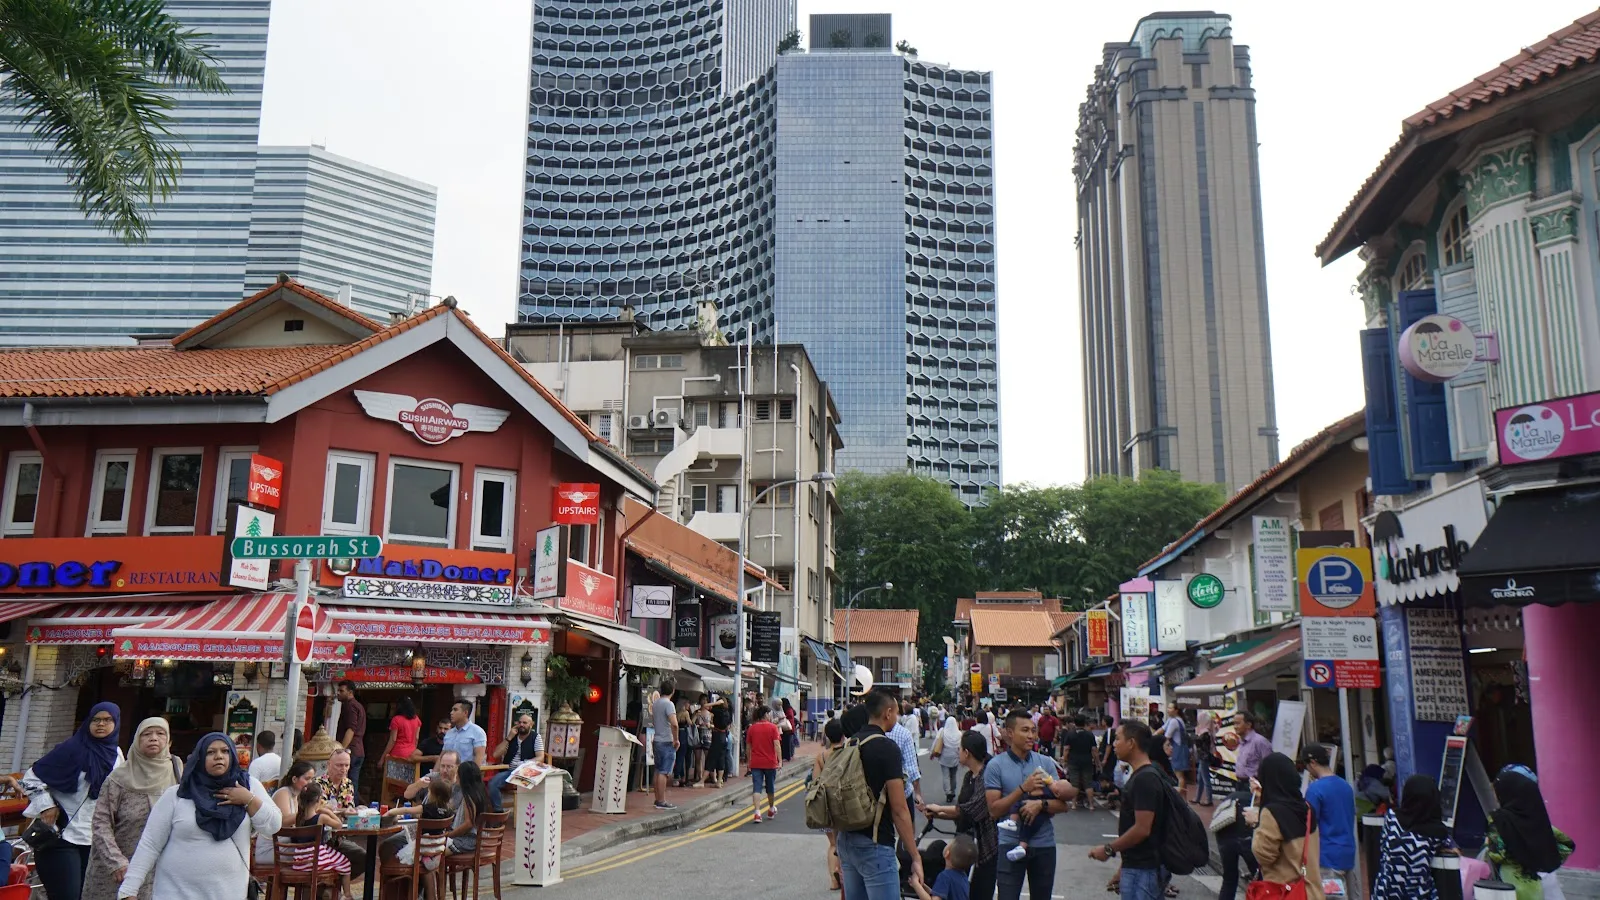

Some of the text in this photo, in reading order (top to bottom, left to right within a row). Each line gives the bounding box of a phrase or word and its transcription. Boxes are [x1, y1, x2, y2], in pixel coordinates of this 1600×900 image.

[1429, 334, 1448, 350] La
[1418, 344, 1473, 362] Marelle
[420, 402, 450, 415] SUSHIBAR
[1521, 422, 1539, 436] La
[1511, 431, 1561, 450] Marelle
[249, 482, 280, 499] UPSTAIRS
[558, 506, 597, 516] UPSTAIRS
[1261, 519, 1283, 529] A.M.
[243, 538, 369, 556] Bussorah St
[357, 556, 511, 583] MakDoner
[1493, 589, 1535, 599] BUSHRA
[45, 629, 104, 638] MAKDONER
[390, 625, 451, 637] LEBANESE
[453, 627, 525, 640] RESTAURANT
[1352, 634, 1373, 643] 60¢
[137, 643, 200, 652] MAKDONER
[203, 643, 261, 654] LEBANESE
[364, 667, 448, 677] MAKDOER
[1415, 668, 1462, 678] AMERICANO
[1416, 695, 1466, 704] CAFE MOCHA
[1417, 711, 1465, 721] ESPRES
